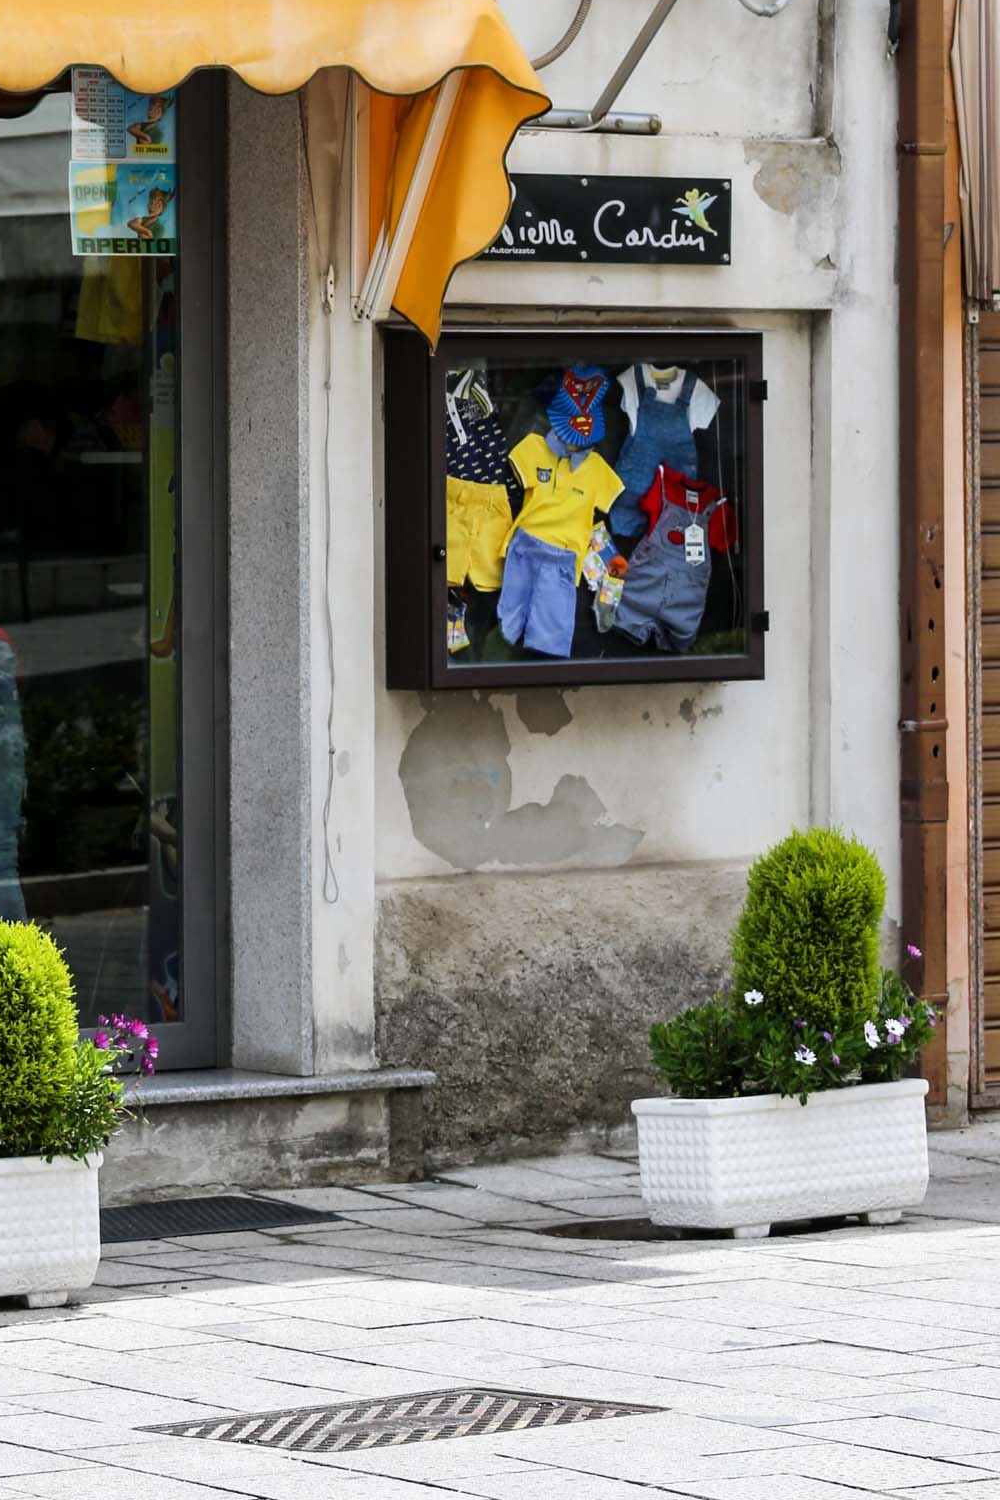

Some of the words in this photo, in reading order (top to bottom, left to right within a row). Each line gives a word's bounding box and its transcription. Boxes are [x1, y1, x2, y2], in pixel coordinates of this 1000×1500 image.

[594, 199, 705, 252] Cardin
[81, 238, 170, 253] APERTO
[490, 246, 536, 256] Autorizzato
